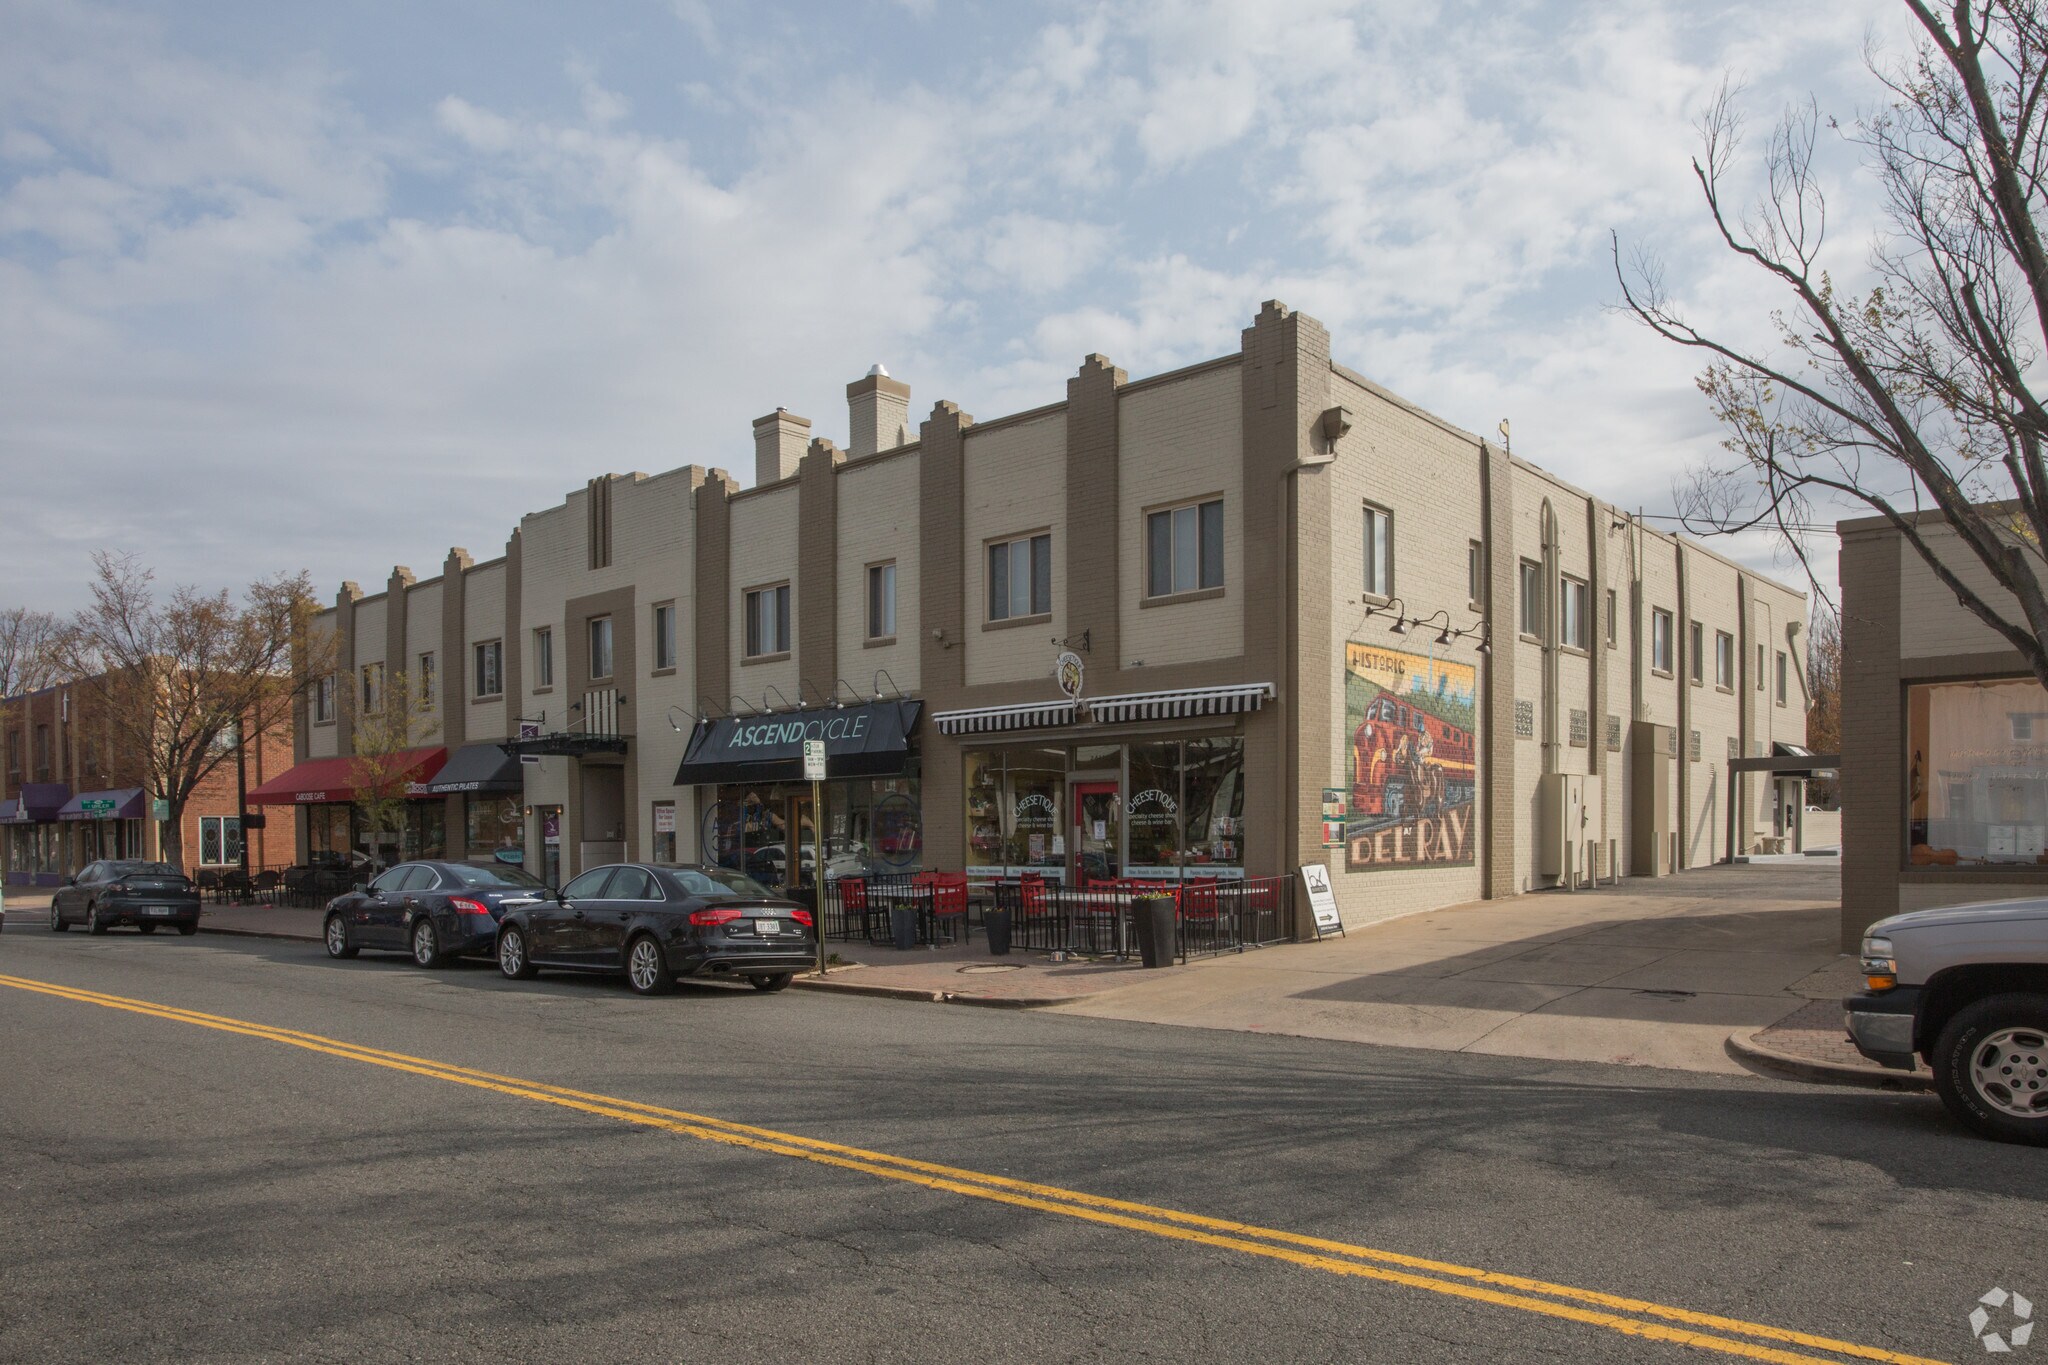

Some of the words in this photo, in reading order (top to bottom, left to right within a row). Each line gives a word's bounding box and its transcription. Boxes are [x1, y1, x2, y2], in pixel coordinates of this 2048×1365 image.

[1353, 650, 1406, 675] HISTORIC
[296, 793, 314, 801] CABOOSE
[314, 792, 326, 800] CAFE
[432, 784, 459, 793] AUTHENTIC
[459, 781, 480, 790] PILATES
[1012, 794, 1059, 817] CHEESETIQUE
[1126, 789, 1178, 814] CHEESETIQUE
